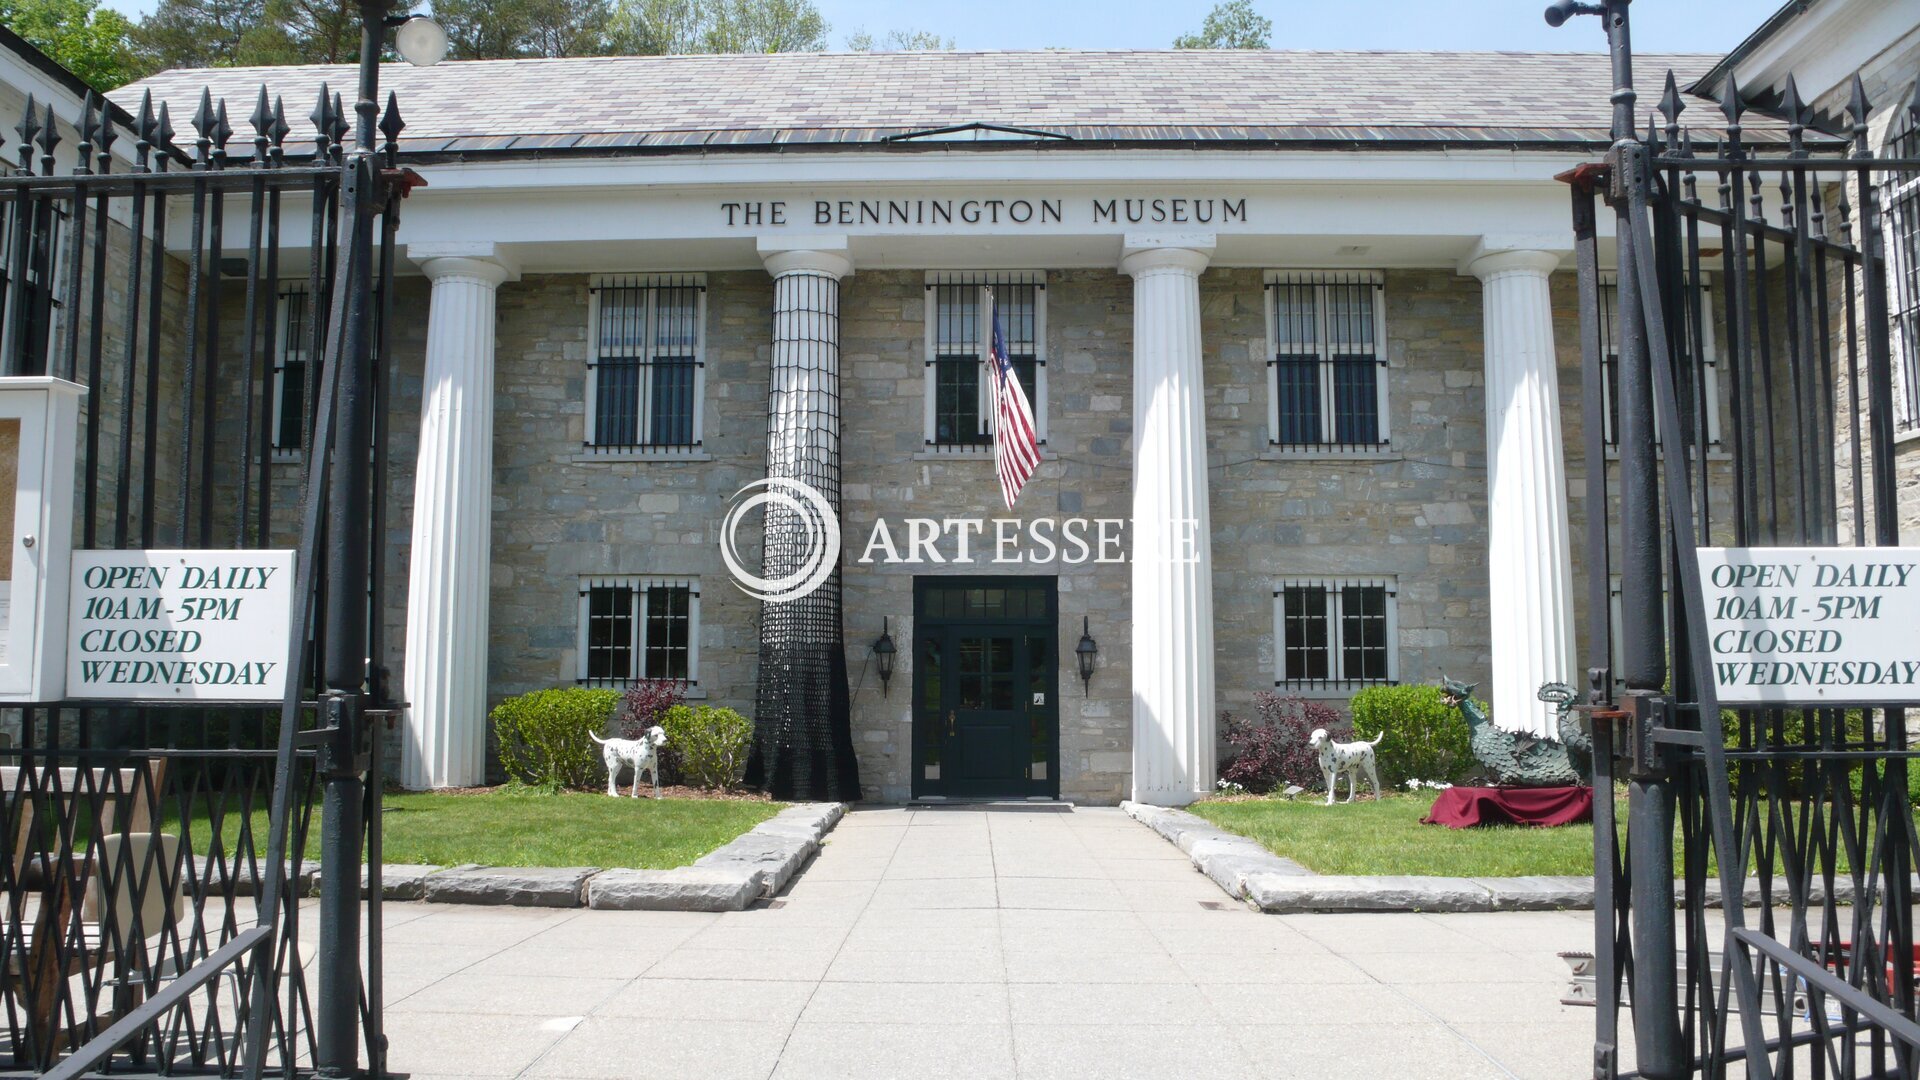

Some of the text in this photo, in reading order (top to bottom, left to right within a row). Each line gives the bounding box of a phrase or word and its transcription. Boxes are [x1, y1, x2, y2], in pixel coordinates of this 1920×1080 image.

[721, 198, 1248, 227] THE BENNINGTON MUSEUM
[84, 566, 277, 590] OPEN DAILY
[1711, 563, 1916, 588] OPEN DAILY
[80, 629, 201, 653] CLOSED
[1713, 629, 1842, 654] CLOSED
[80, 661, 276, 685] WEDNESDAY
[1715, 661, 1920, 686] WEDNESDAY
